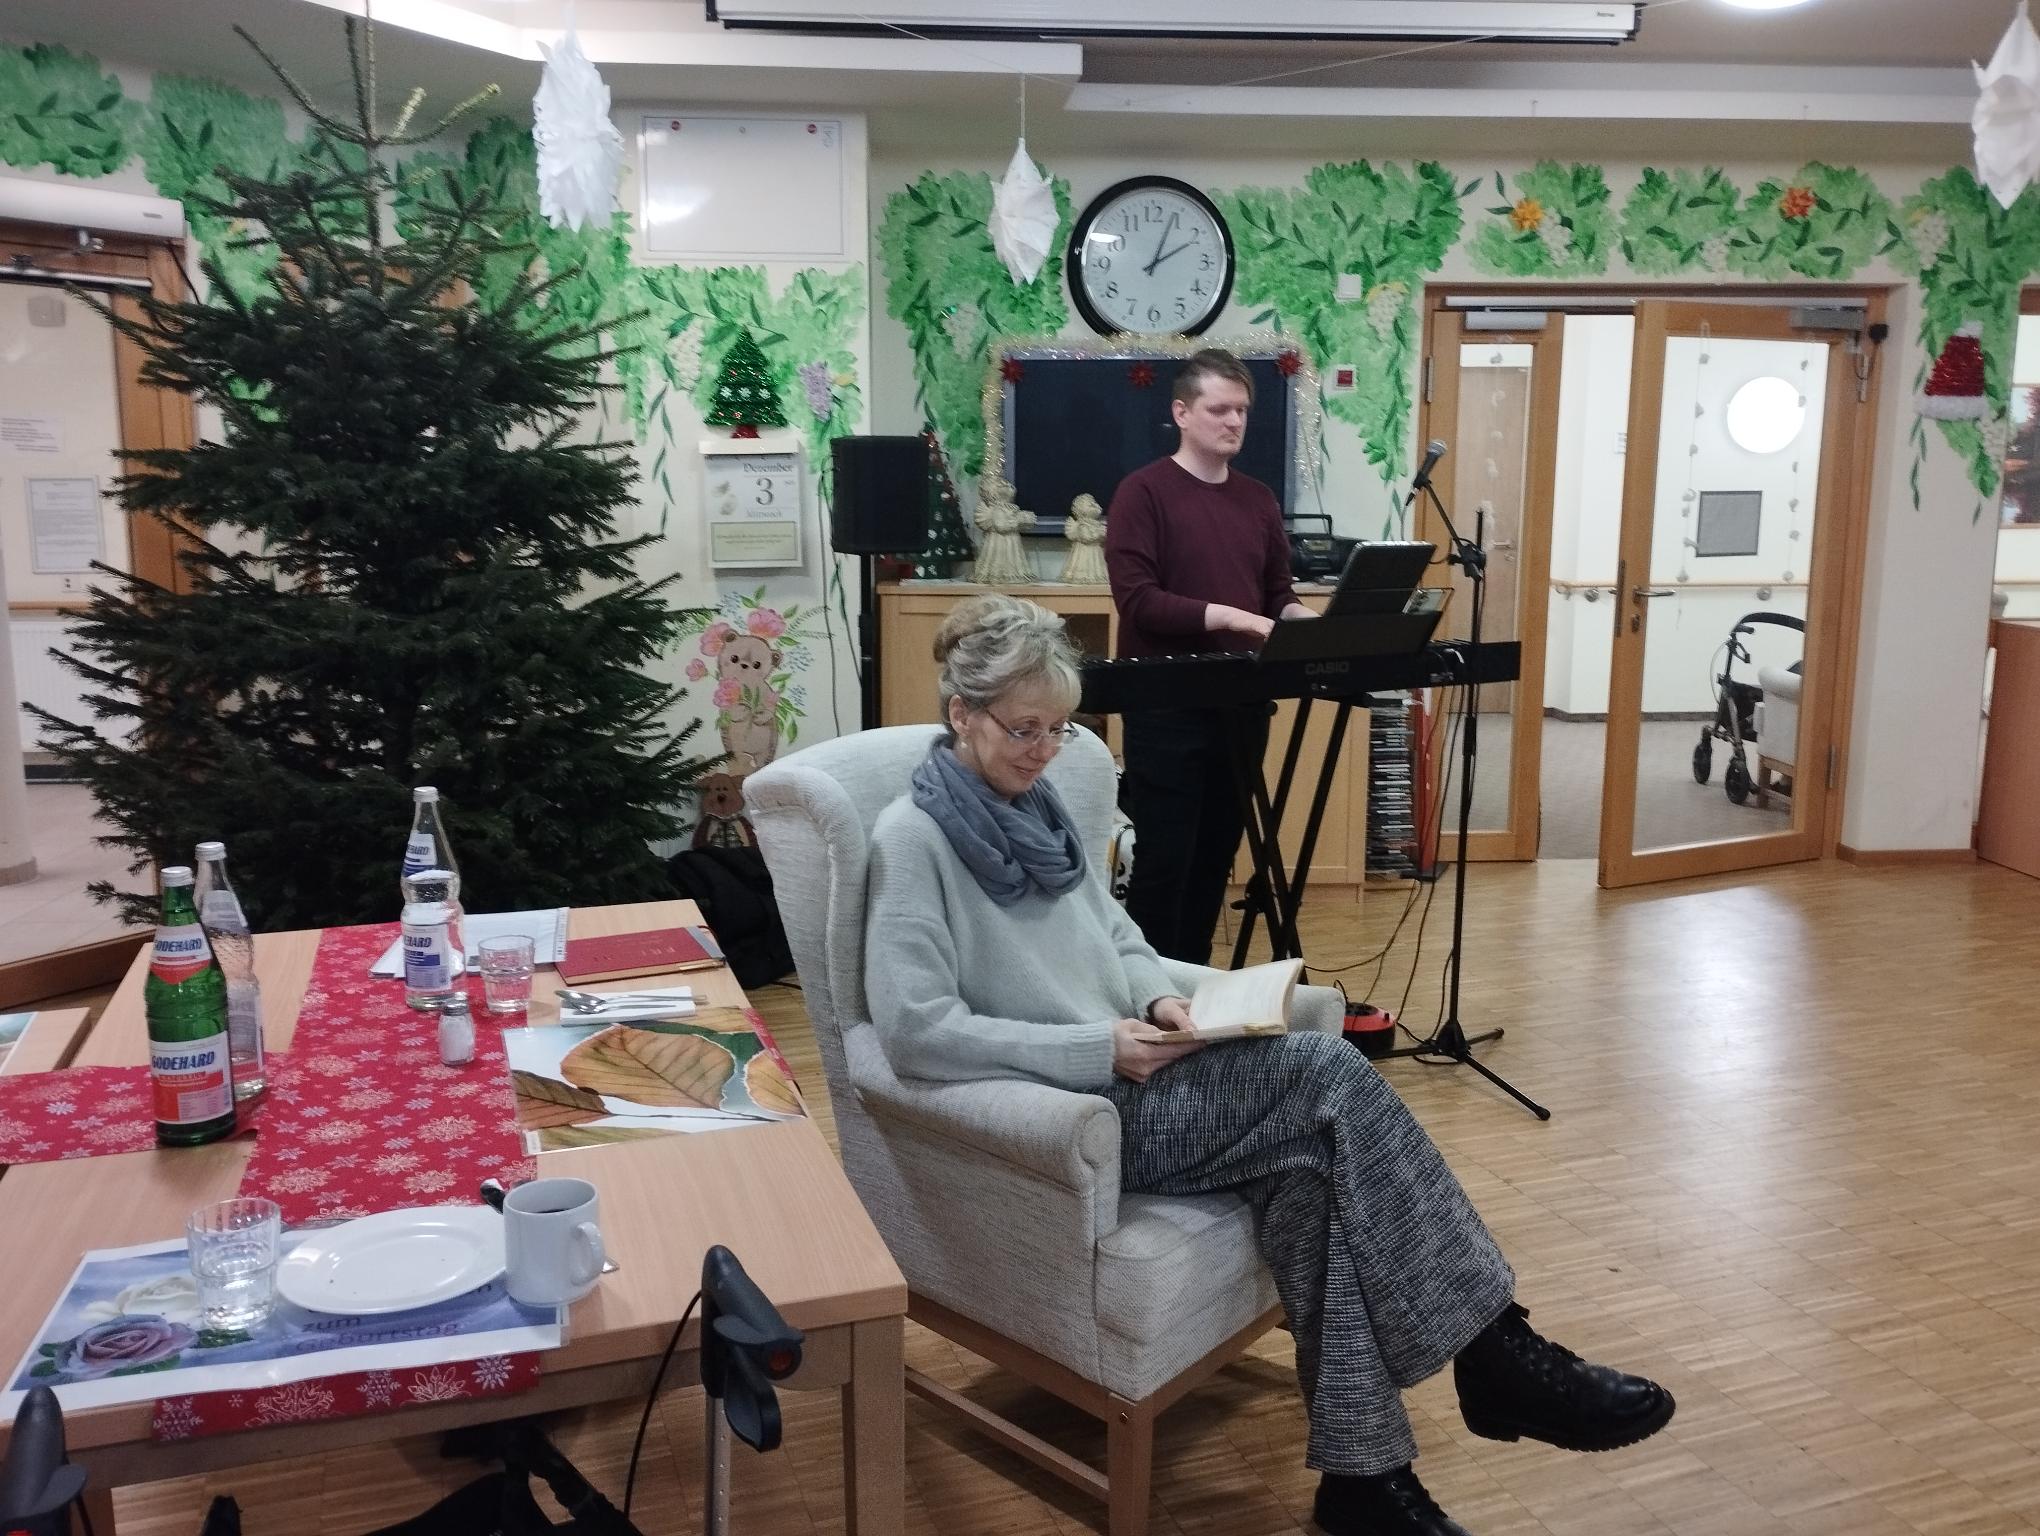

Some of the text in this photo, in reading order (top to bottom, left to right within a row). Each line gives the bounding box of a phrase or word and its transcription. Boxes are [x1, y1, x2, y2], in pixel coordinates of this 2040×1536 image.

[1123, 214, 1139, 232] 11
[1143, 206, 1163, 223] 12
[1189, 227, 1200, 244] 2
[1098, 256, 1111, 272] 9
[1199, 252, 1210, 271] 3
[1105, 281, 1119, 299] 8
[1125, 298, 1138, 316] 7
[1148, 303, 1161, 322] 6
[1175, 297, 1187, 319] 5
[756, 477, 774, 506] 3
[1304, 660, 1350, 676] CASIO
[301, 1316, 361, 1333] zum
[296, 1323, 460, 1351] Geburtstag
